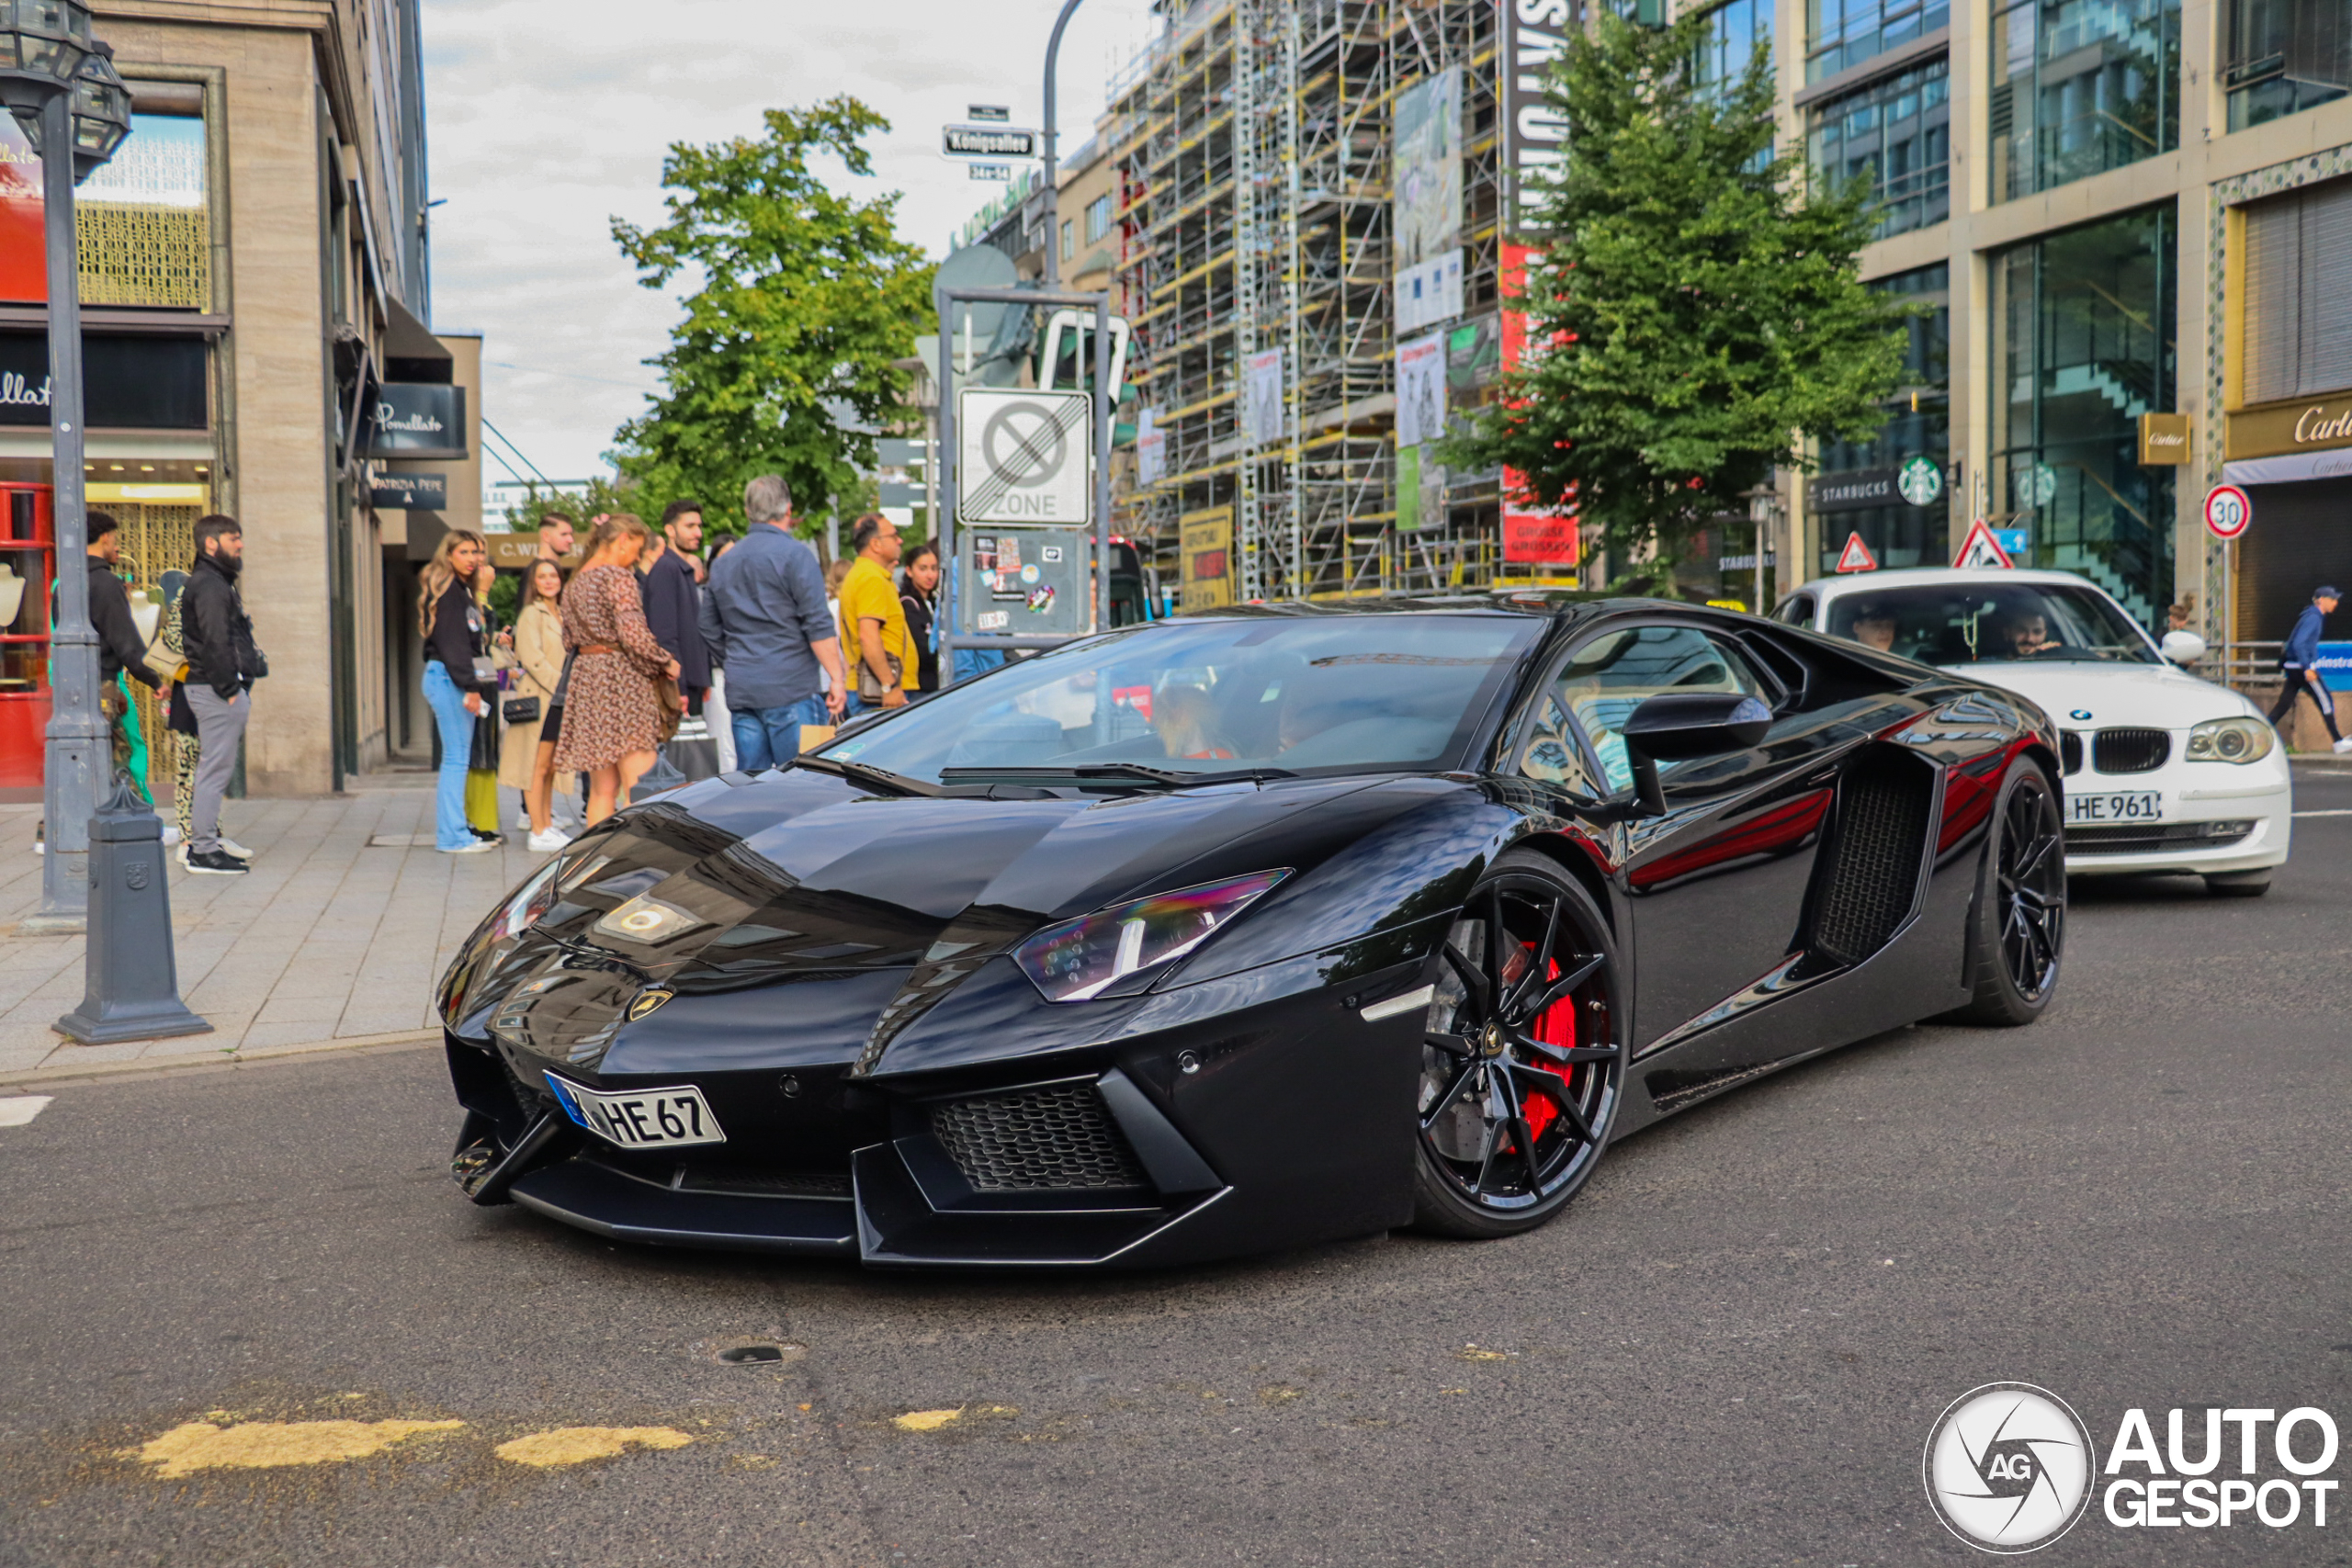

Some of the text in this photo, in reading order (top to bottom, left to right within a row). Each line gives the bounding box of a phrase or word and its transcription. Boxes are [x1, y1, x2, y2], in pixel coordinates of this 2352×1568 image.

[952, 131, 1028, 153] Königsallee
[378, 401, 444, 432] Pomellato
[2148, 433, 2185, 446] Cartier
[374, 478, 444, 491] PATRIZIA PEPE
[1823, 480, 1889, 502] STARBUCKS
[993, 494, 1056, 515] ZONE
[2213, 502, 2240, 525] 30
[1517, 526, 1565, 538] GROSSE
[1719, 554, 1775, 571] STARBUKS
[2075, 795, 2154, 819] HE 961
